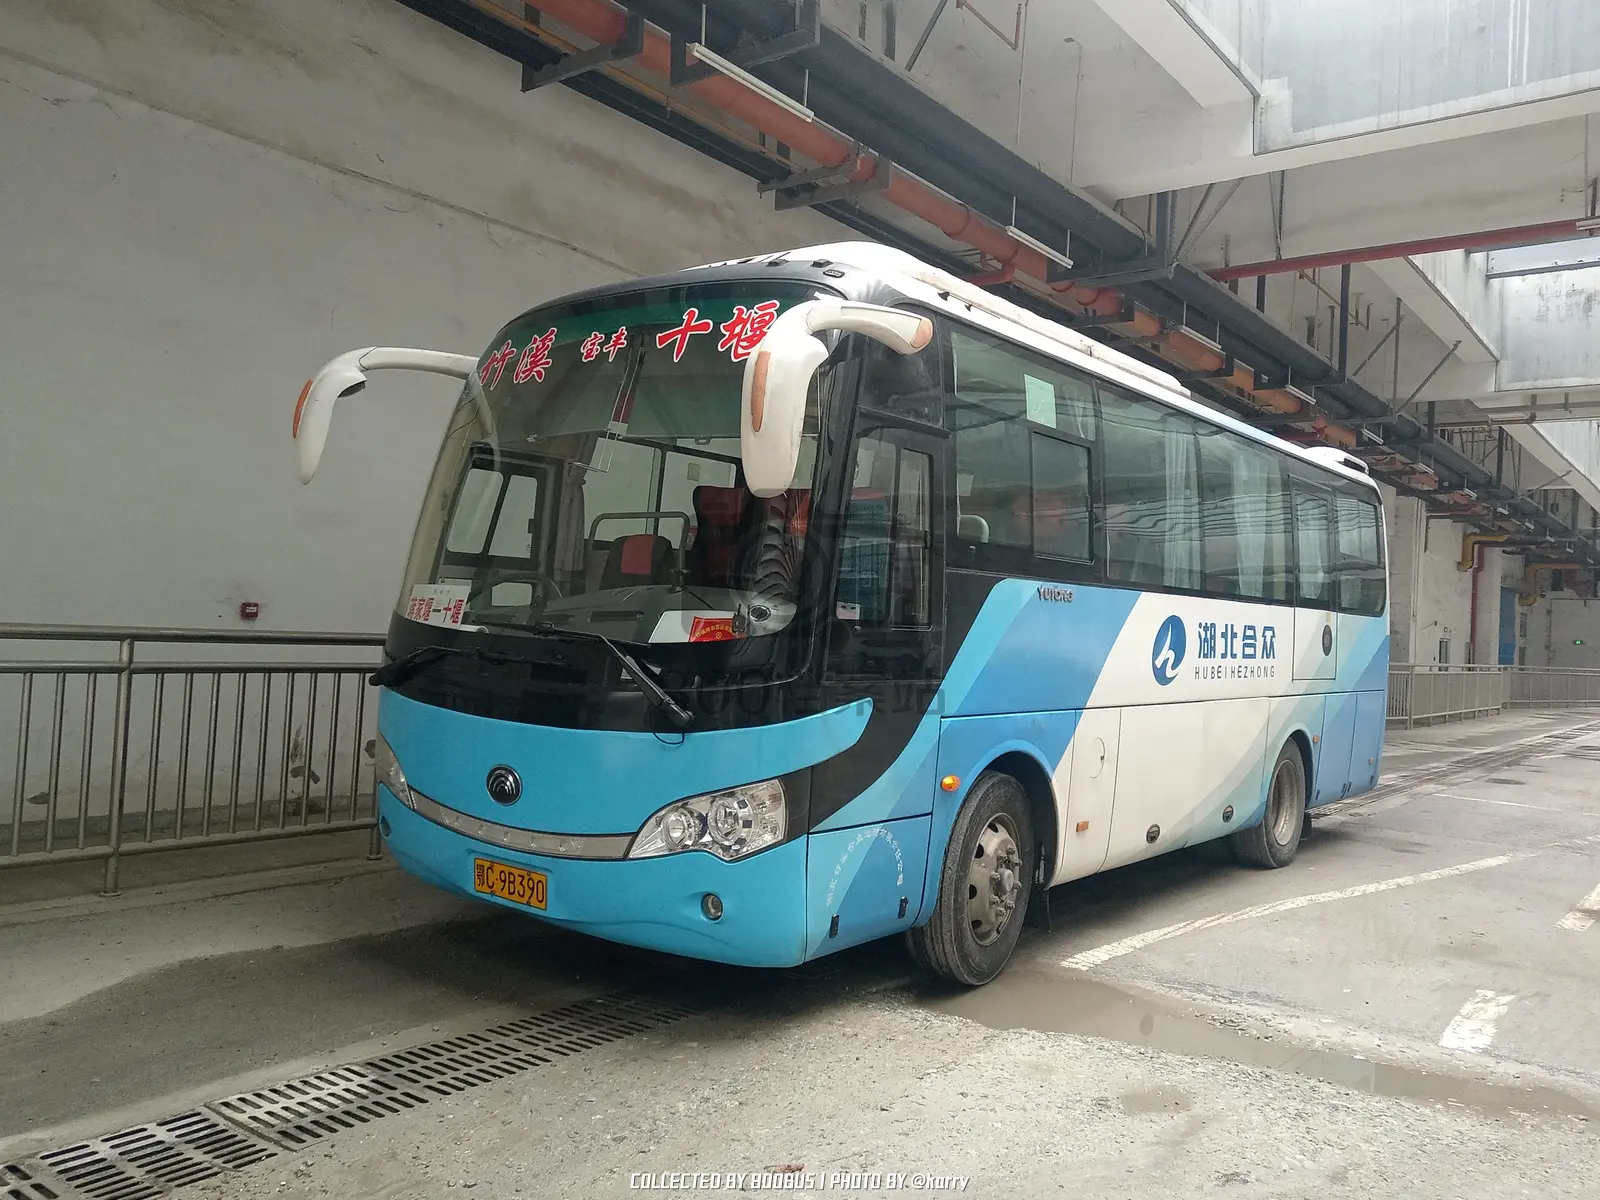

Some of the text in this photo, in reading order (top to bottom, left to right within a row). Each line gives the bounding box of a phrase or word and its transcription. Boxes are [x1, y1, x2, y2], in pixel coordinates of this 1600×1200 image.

[480, 299, 780, 390] 竹溪 宝丰 十堰
[1036, 585, 1075, 604] YUTONG
[1197, 621, 1276, 660] 湖北合众
